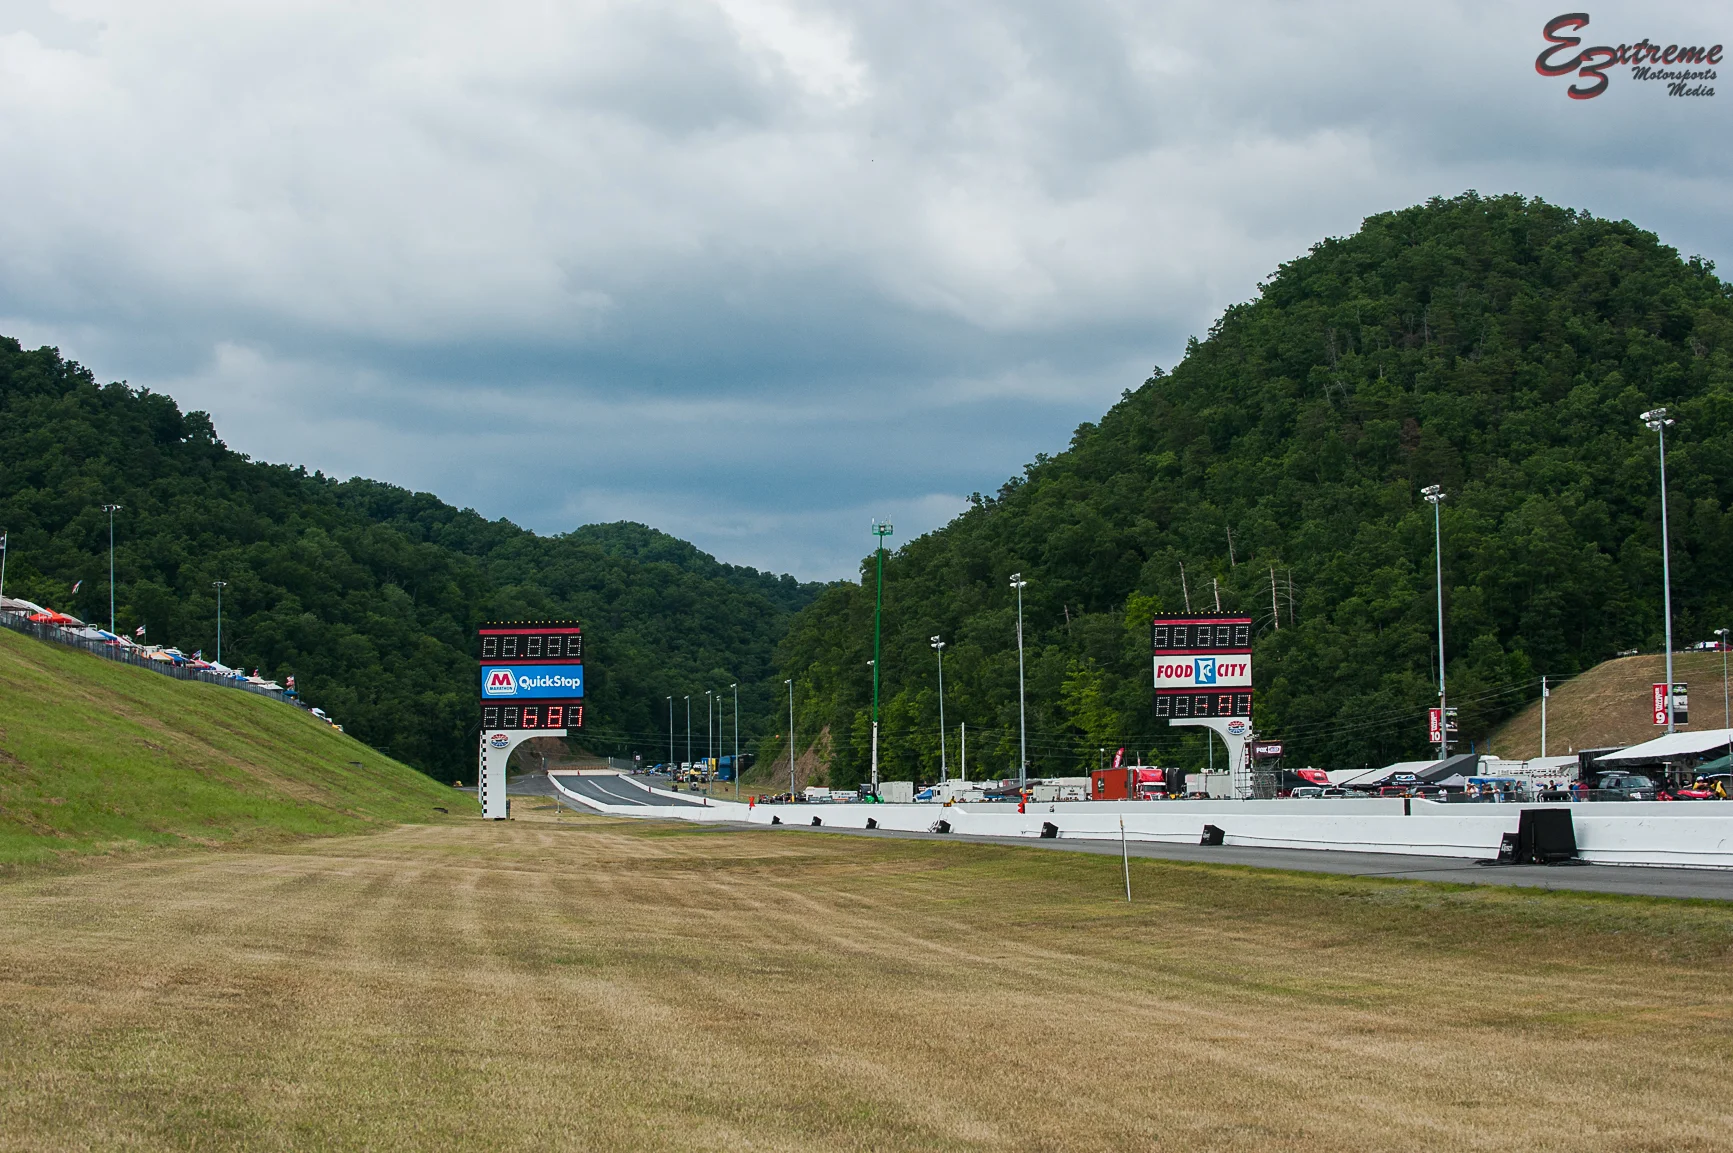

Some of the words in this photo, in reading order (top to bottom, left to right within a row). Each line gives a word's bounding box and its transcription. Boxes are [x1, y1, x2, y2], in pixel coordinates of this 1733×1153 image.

[1157, 664, 1194, 678] FOOD
[1217, 663, 1247, 677] CITY
[491, 673, 511, 686] M
[518, 675, 581, 691] QuickStop
[1656, 712, 1665, 724] 9
[1431, 731, 1440, 741] 10
